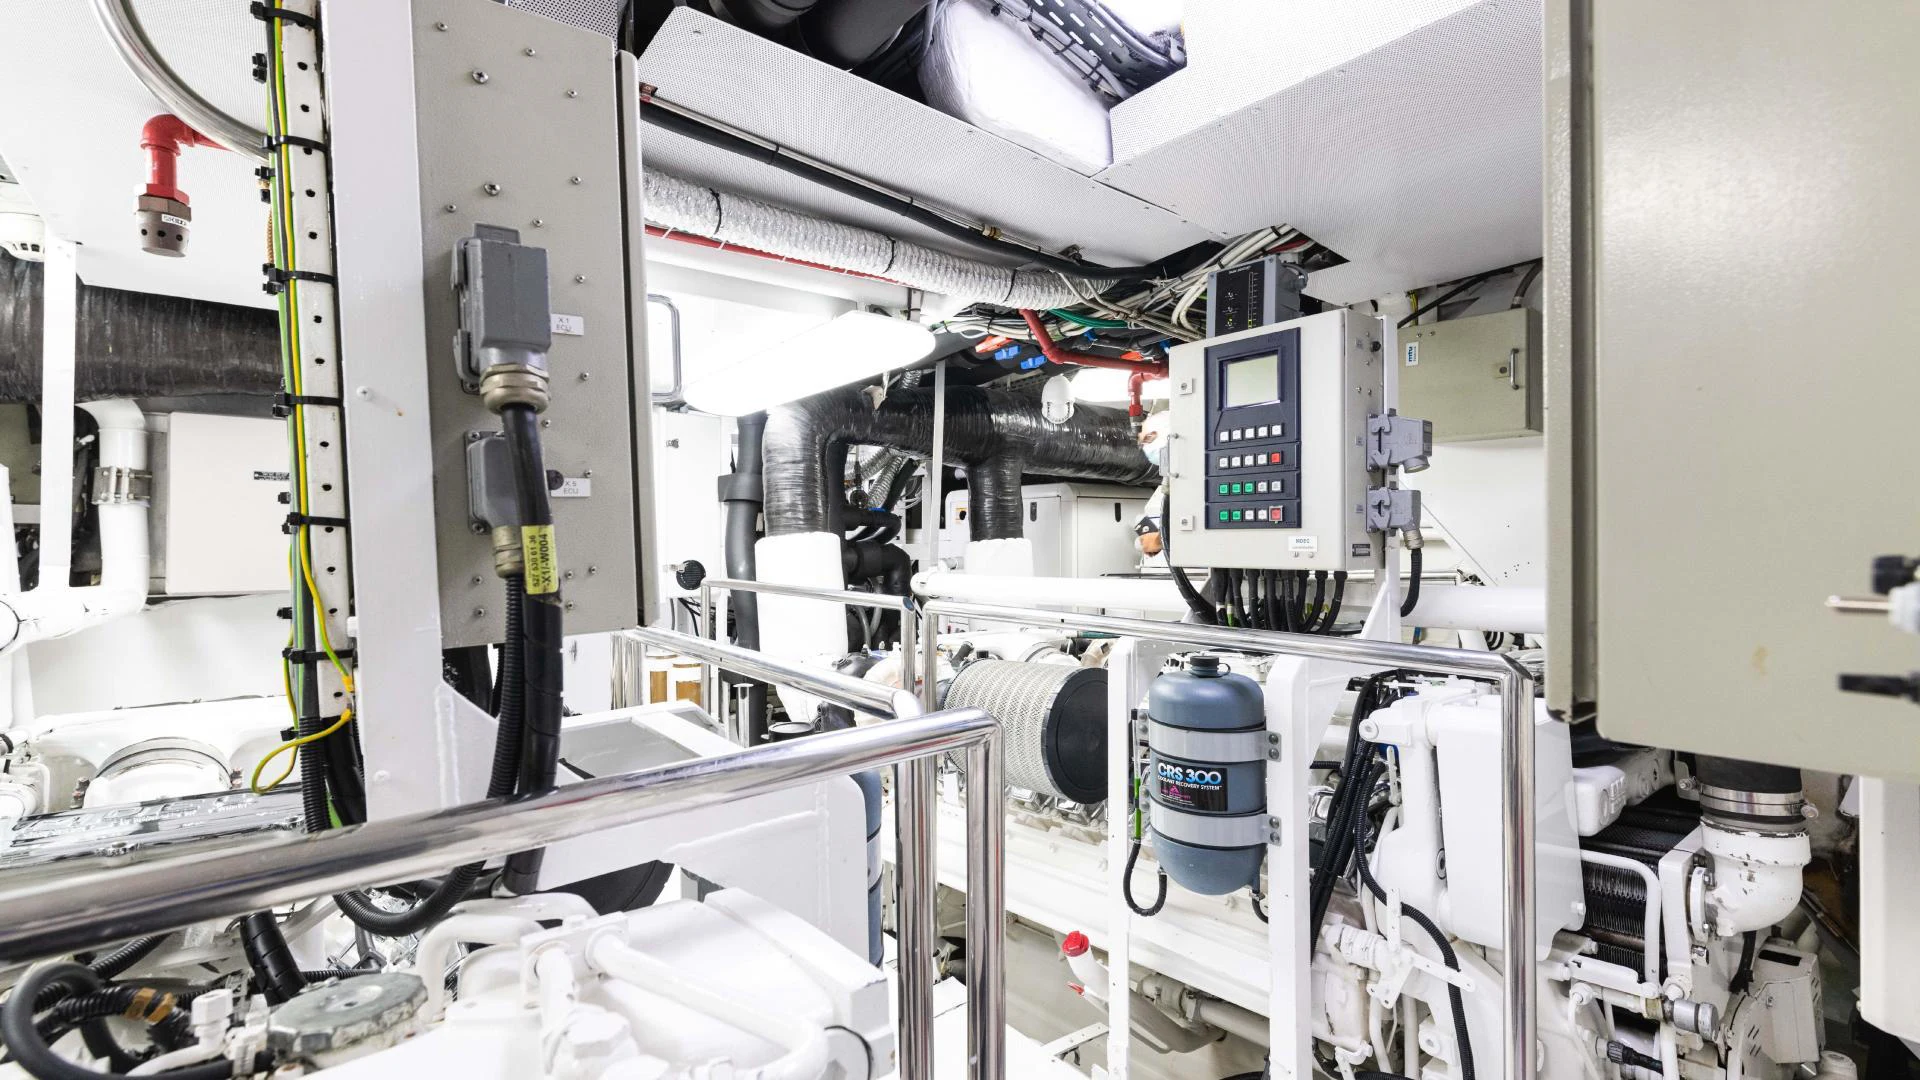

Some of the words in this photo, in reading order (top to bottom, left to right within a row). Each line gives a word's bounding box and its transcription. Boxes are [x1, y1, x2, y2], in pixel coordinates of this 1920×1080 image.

[1157, 775, 1175, 784] COOLANT
[1176, 781, 1200, 789] RECOVERY
[1158, 762, 1184, 780] CRS
[1186, 768, 1222, 784] 300
